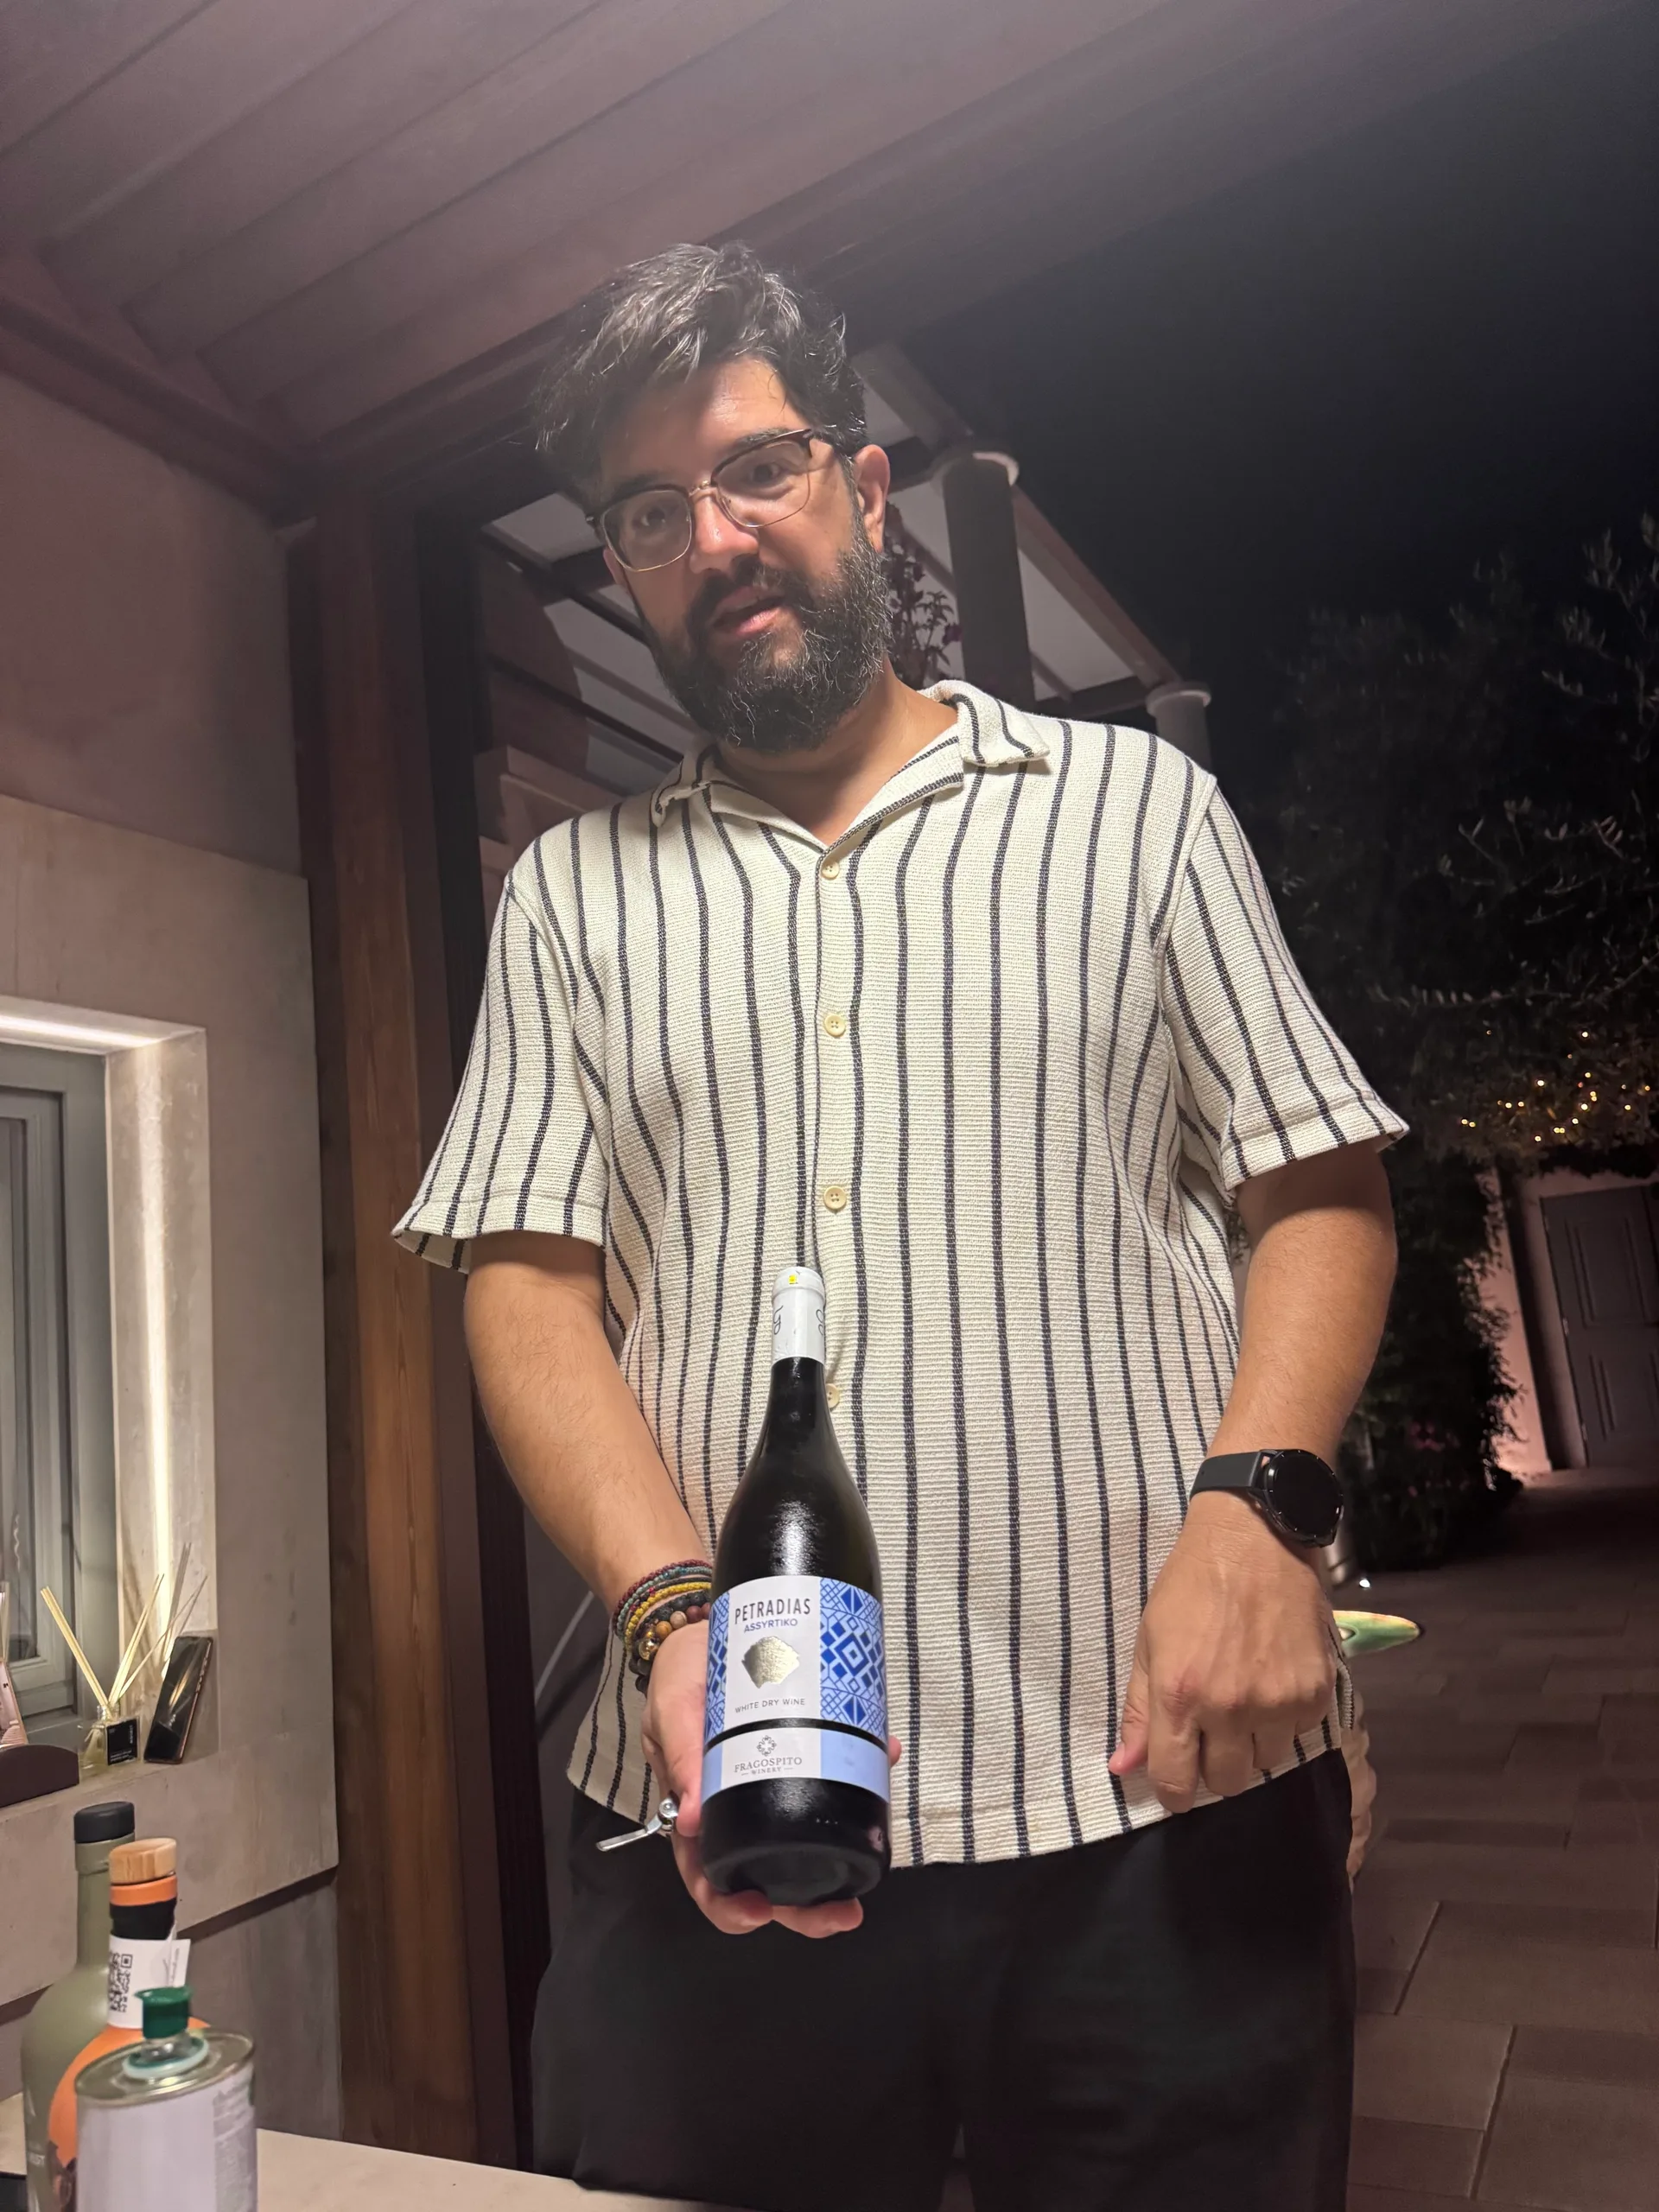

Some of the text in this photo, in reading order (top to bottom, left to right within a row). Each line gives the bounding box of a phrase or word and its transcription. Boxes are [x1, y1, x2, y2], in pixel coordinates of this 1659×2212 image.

[734, 1599, 810, 1624] PETRADIAS
[744, 1618, 798, 1633] ASSYRTIKO
[734, 1701, 760, 1713] WHITE
[761, 1699, 779, 1707] DRY
[734, 1757, 803, 1773] FRAGOSPITO
[751, 1766, 781, 1775] WINERY
